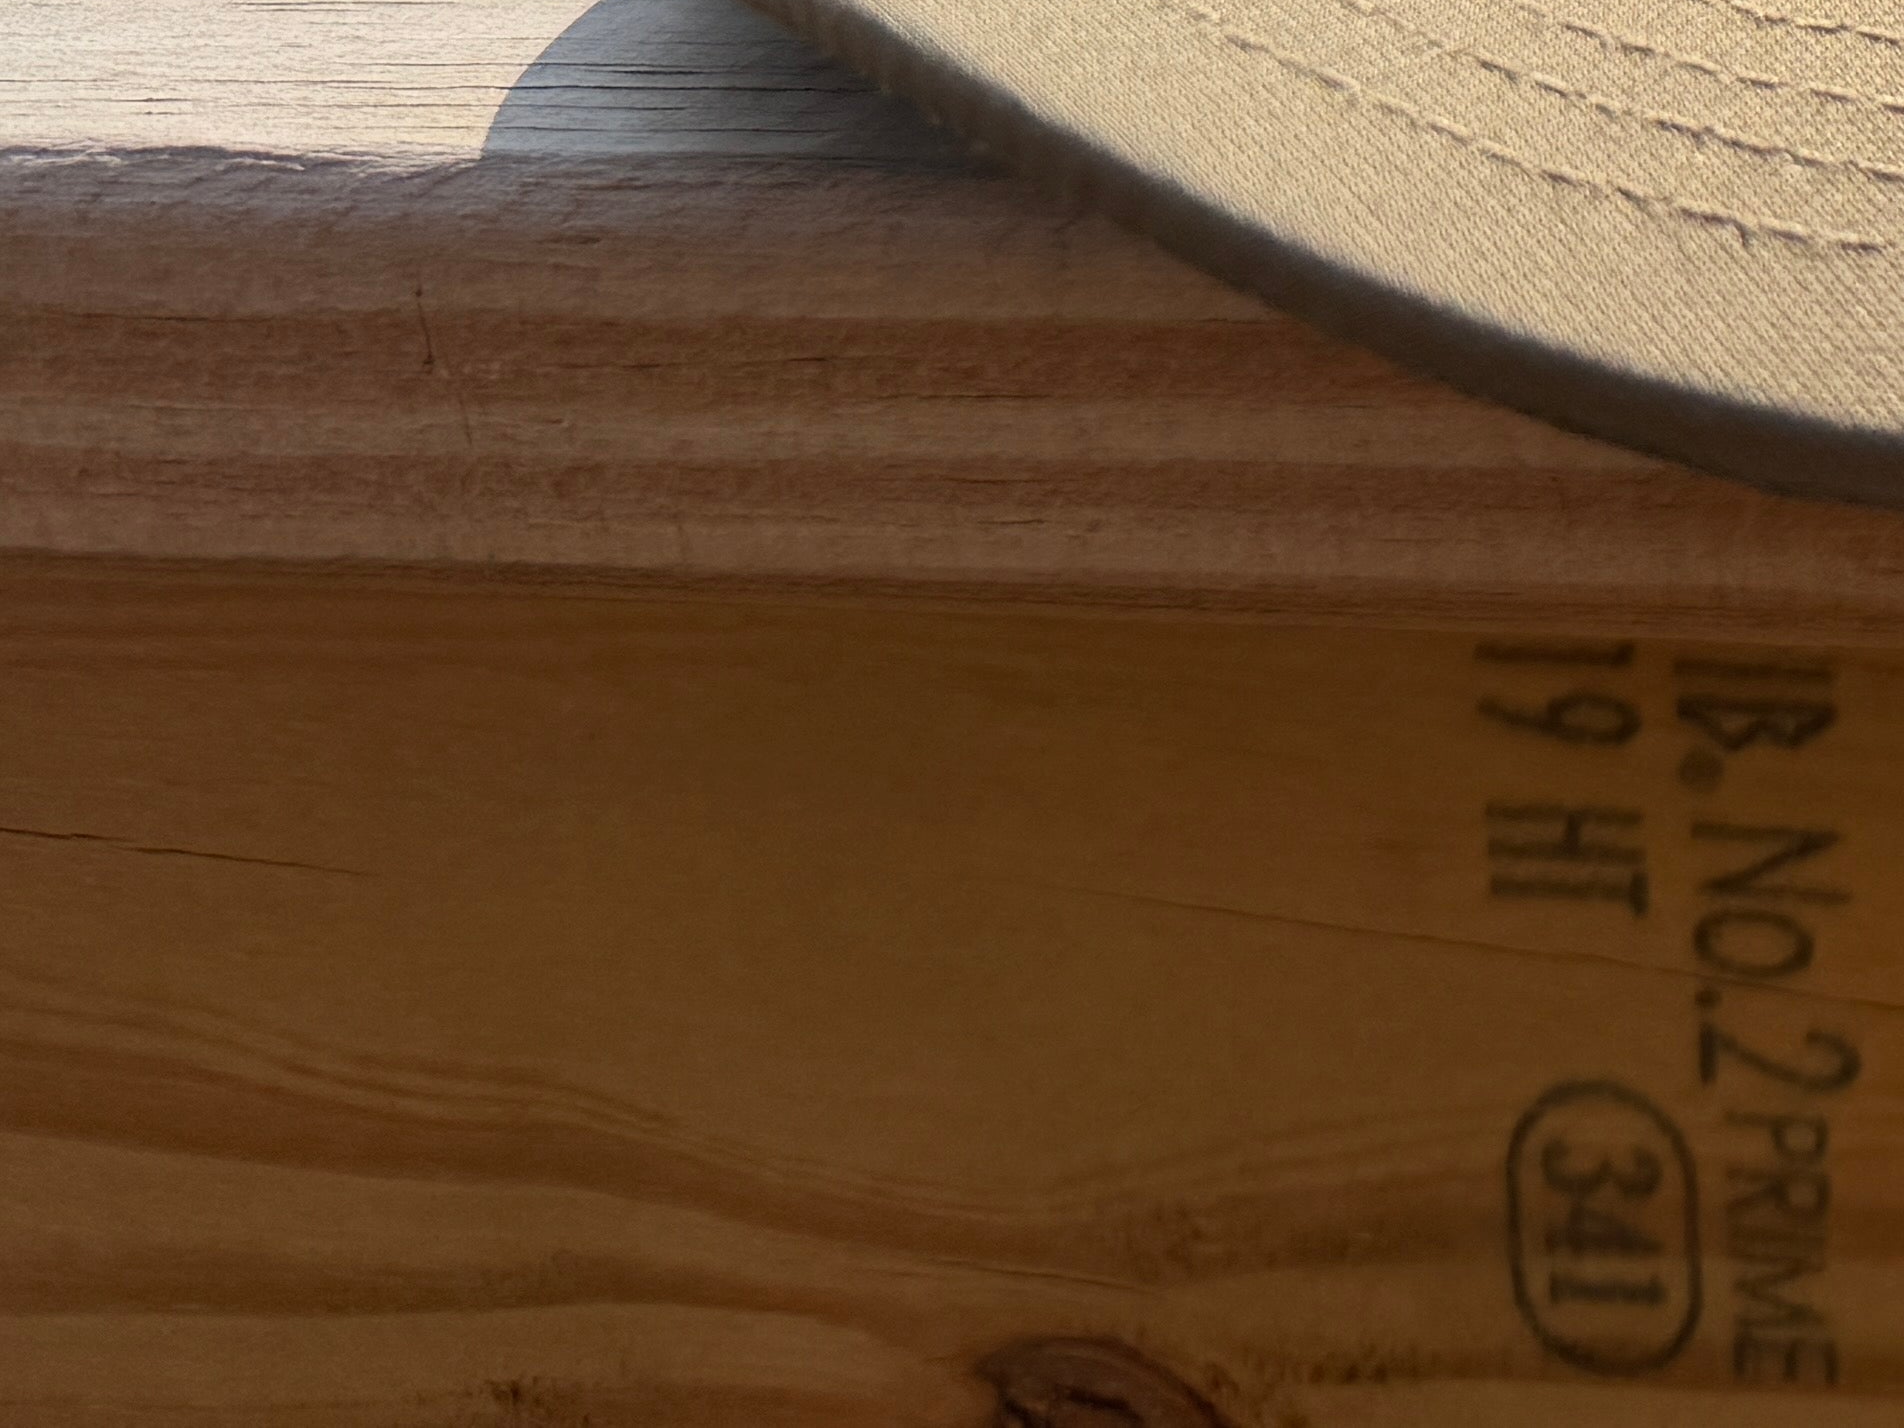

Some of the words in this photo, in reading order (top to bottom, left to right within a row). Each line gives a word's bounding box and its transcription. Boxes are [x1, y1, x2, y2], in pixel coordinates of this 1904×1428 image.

[1483, 800, 1651, 918] HT
[1540, 1134, 1670, 1309] 341
[1722, 1108, 1841, 1386] PRIME
